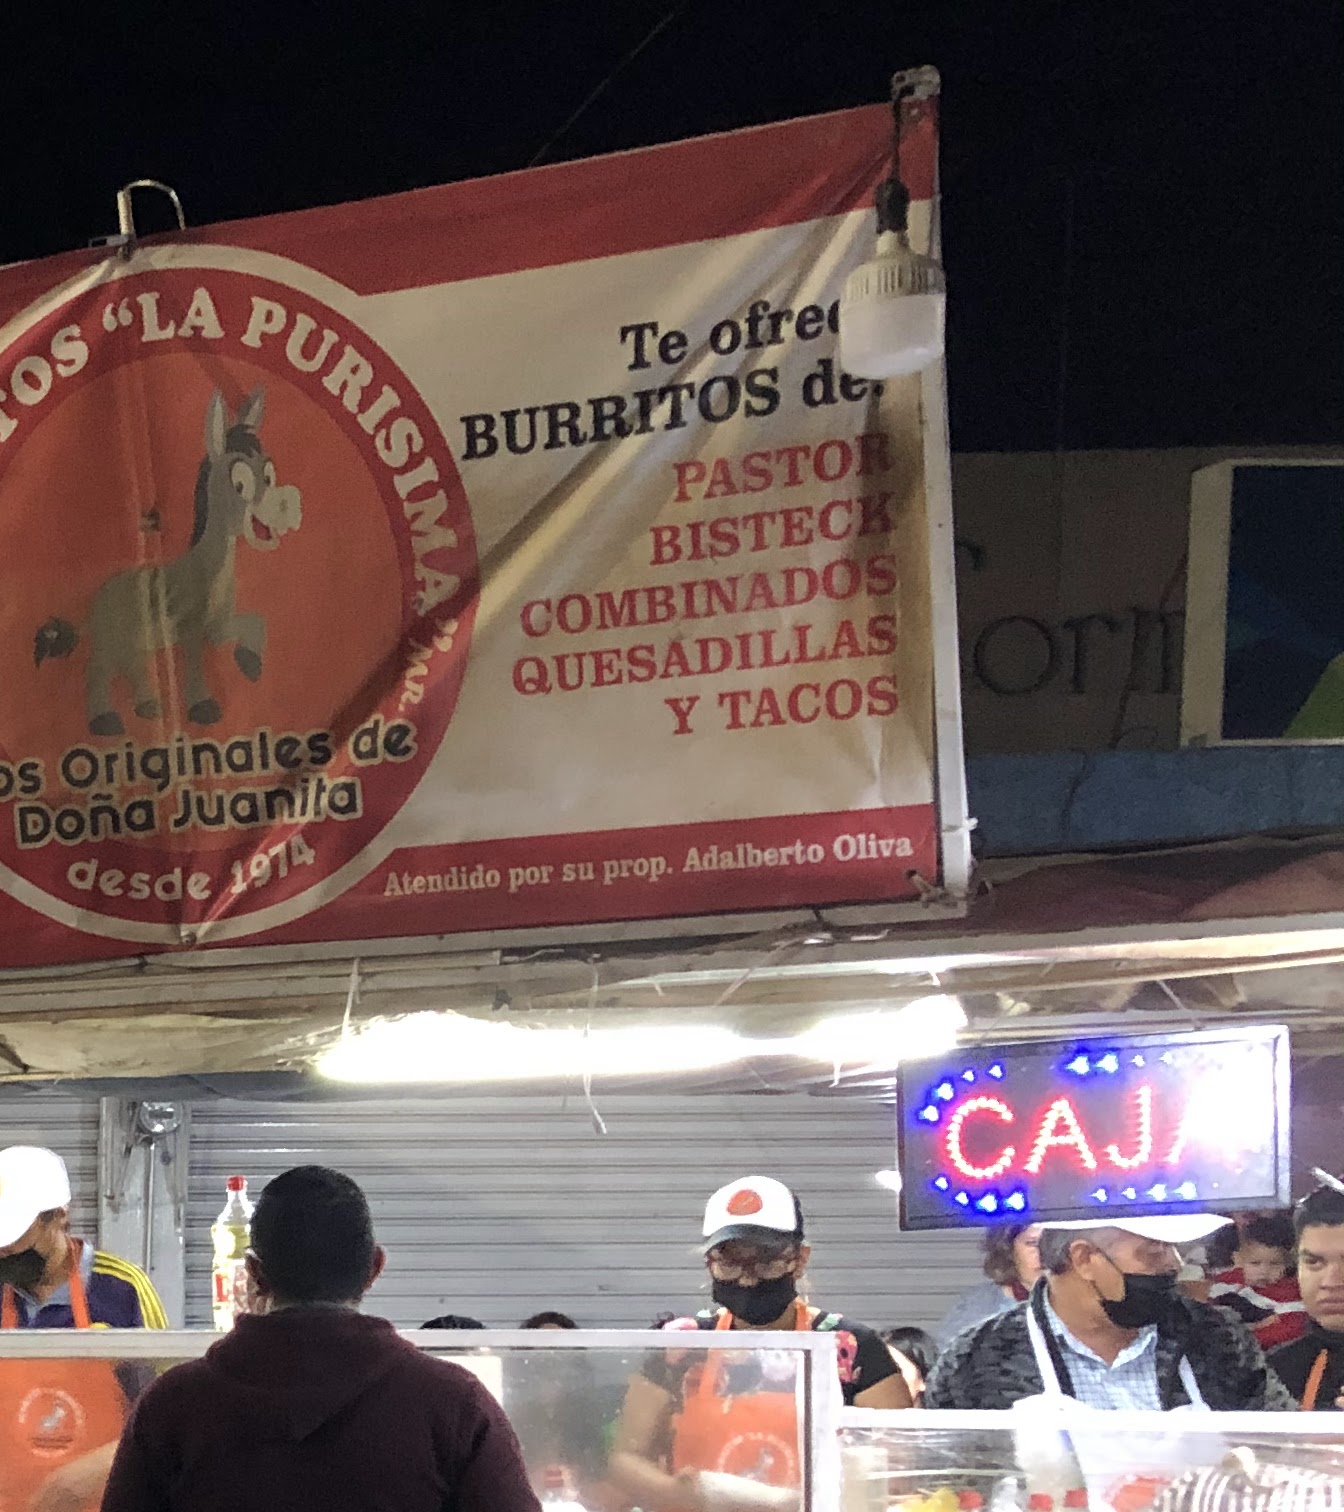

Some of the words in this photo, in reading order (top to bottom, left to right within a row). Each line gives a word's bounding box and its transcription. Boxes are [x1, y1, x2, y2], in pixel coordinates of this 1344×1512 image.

[620, 322, 688, 371] Te
[460, 367, 780, 461] BURRITOS
[673, 432, 893, 503] PASTOR
[650, 492, 897, 566] BISTECK
[519, 555, 898, 639] COMBINADOS
[513, 615, 899, 697] QUESADILLAS
[664, 695, 702, 736] Y
[718, 676, 900, 731] TACOS
[62, 729, 332, 793] Originales
[352, 716, 414, 760] de
[18, 791, 156, 845] Doña
[173, 777, 359, 829] Juanita
[67, 857, 212, 901] desde
[230, 836, 316, 895] 1974
[384, 864, 501, 897] Atendido
[508, 864, 554, 893] por
[562, 862, 595, 883] su
[603, 854, 673, 886] prop.
[683, 842, 825, 874] Adalberto
[832, 833, 914, 862] Oliva
[944, 1083, 1202, 1180] CAJ
